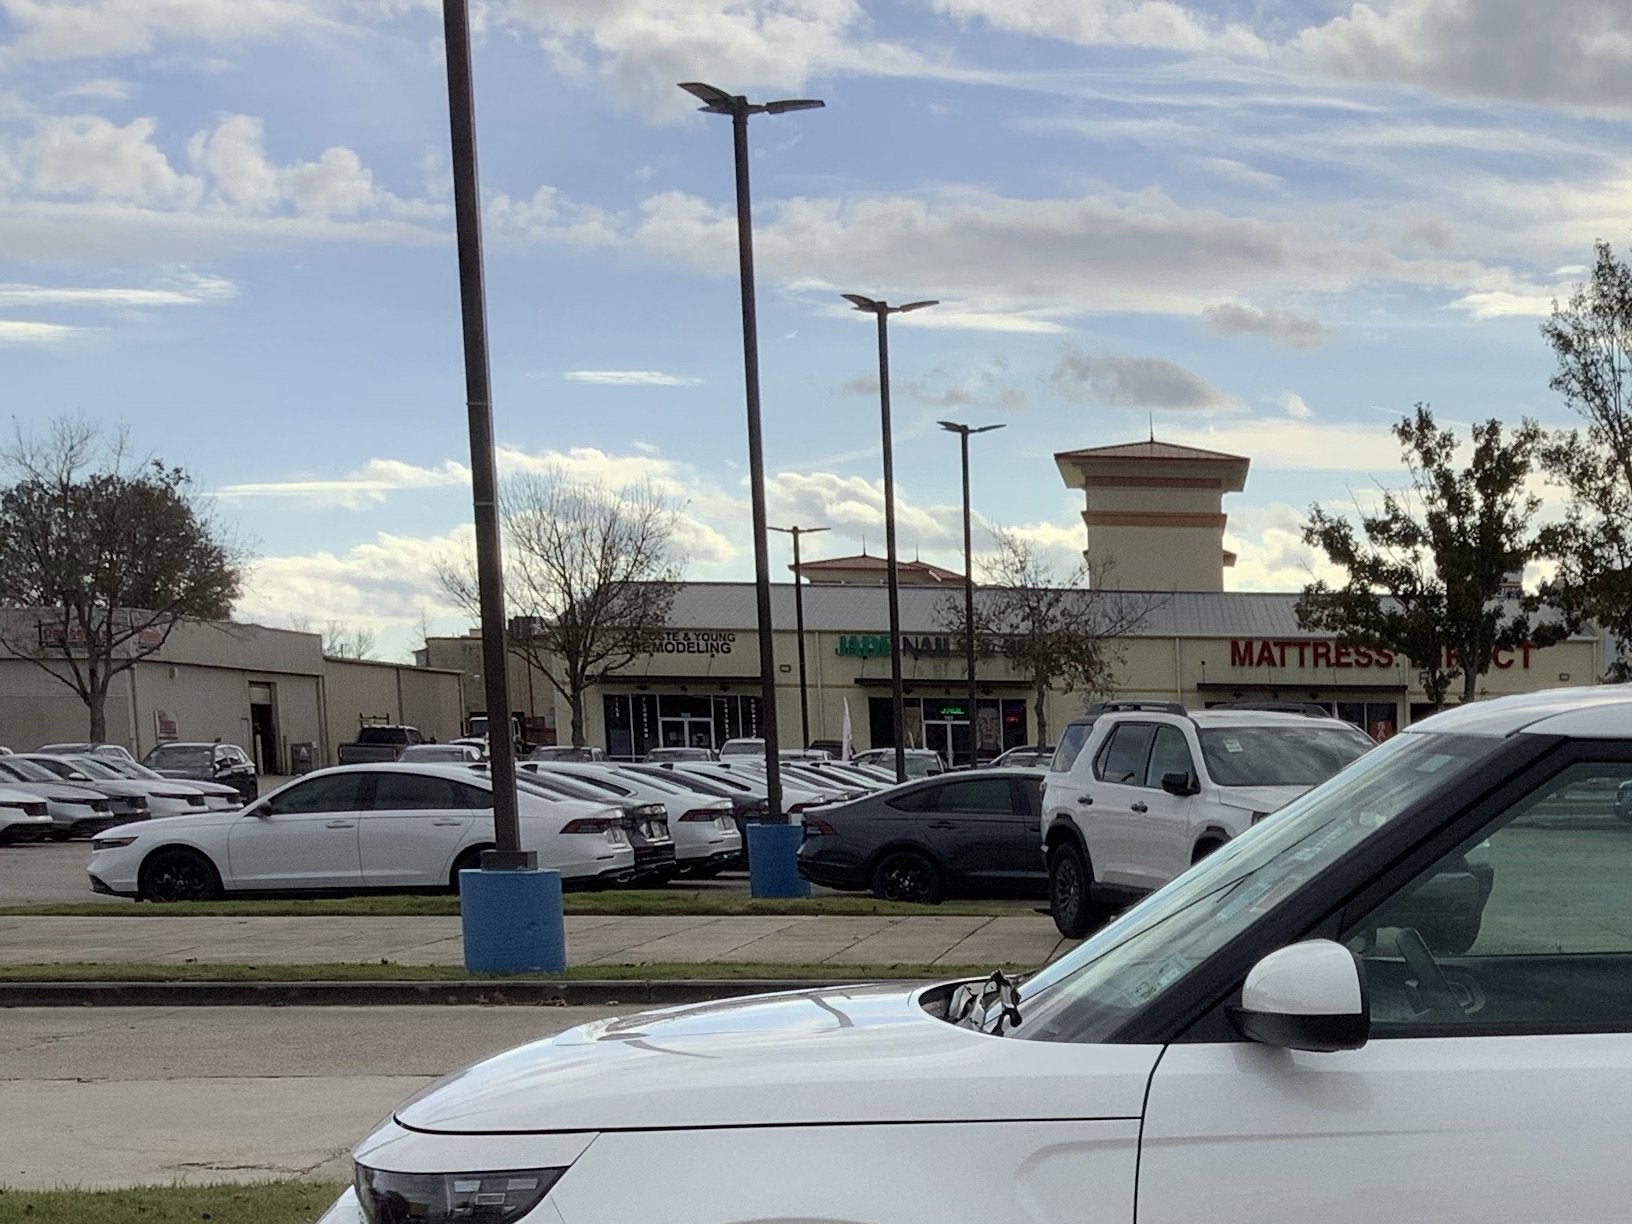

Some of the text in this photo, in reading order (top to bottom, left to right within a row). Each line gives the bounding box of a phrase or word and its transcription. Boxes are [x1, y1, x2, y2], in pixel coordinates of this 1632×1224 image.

[684, 633, 691, 642] &
[694, 632, 736, 642] YOUNG
[1230, 640, 1394, 669] MATTRESS
